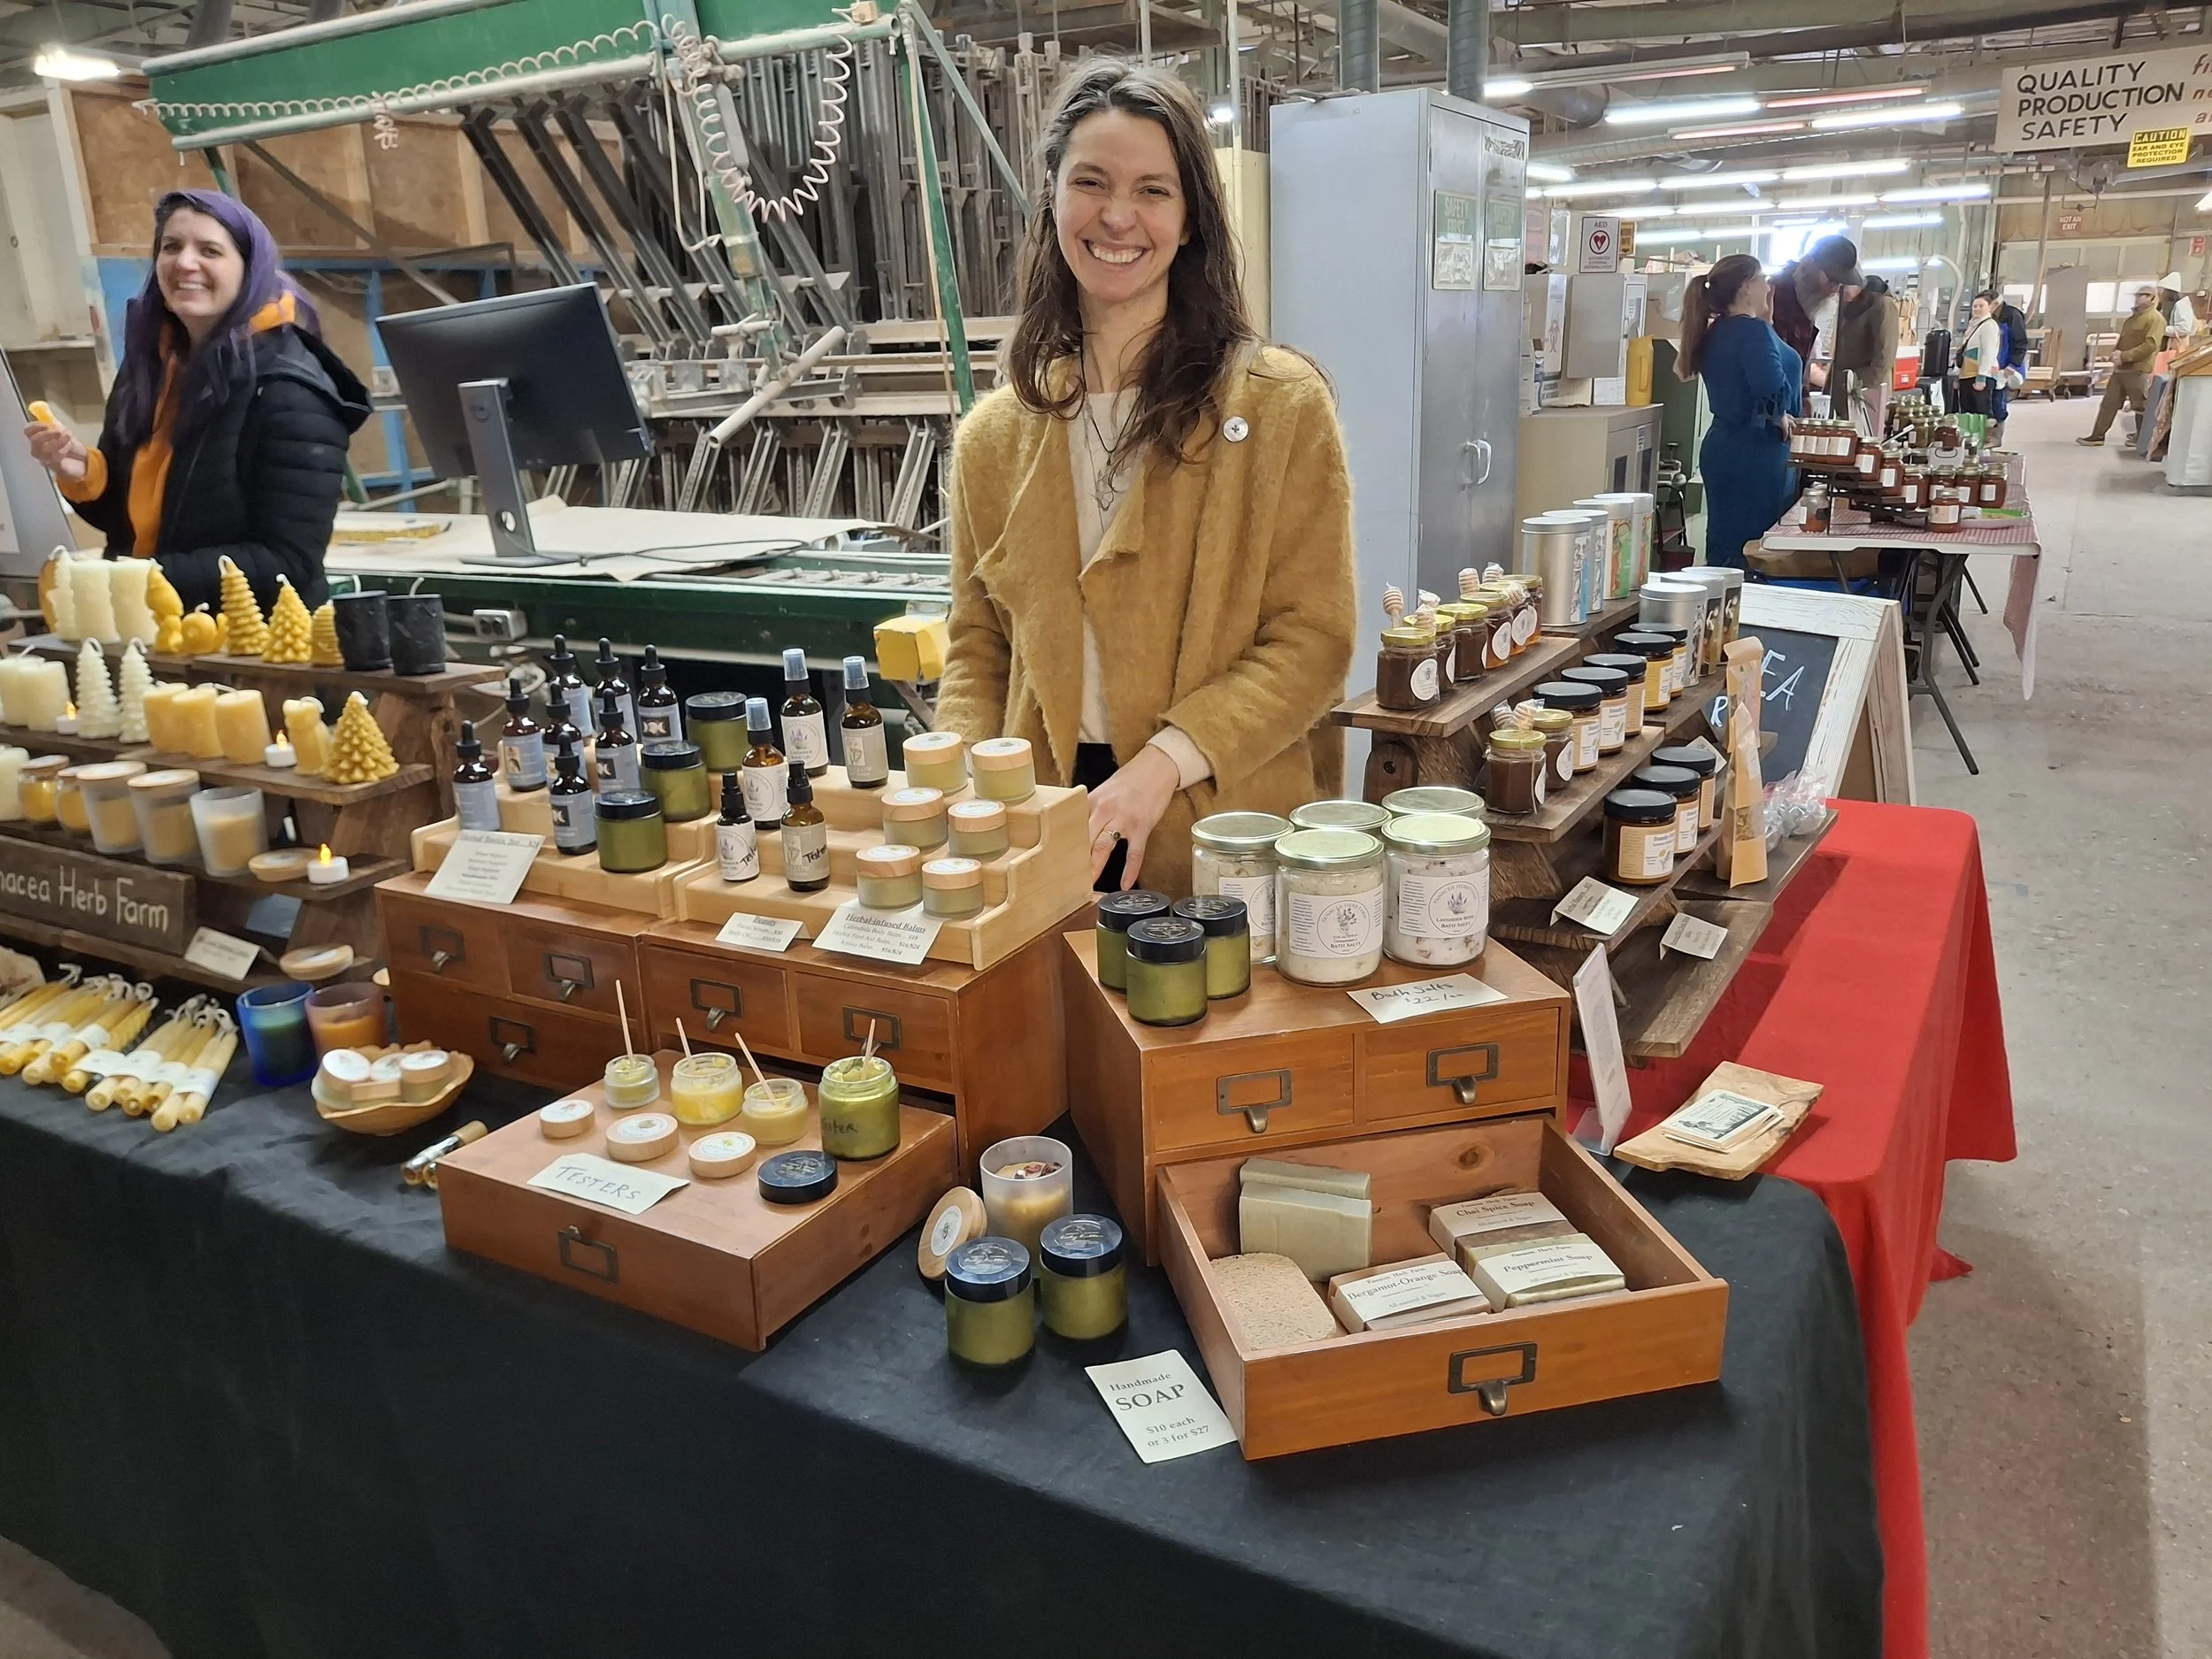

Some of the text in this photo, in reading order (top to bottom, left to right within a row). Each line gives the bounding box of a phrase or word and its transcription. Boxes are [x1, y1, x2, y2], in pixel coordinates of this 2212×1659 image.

[2016, 61, 2146, 95] QUALITY
[2017, 82, 2185, 117] PRODUCTION
[2021, 113, 2128, 141] SAFETY
[2135, 129, 2186, 143] CAUTION
[2132, 149, 2184, 157] PROTECTION
[2136, 155, 2177, 164] REQUIRED
[1444, 196, 1469, 219] SAFETY
[59, 864, 108, 916] Herb
[116, 877, 169, 933] Farm
[902, 923, 926, 933] Balms
[1371, 983, 1454, 1001] Bath Salts
[555, 1166, 641, 1200] TESTERS
[1456, 1207, 1480, 1217] Chai
[1503, 1256, 1564, 1272] Peppermint
[1347, 1273, 1438, 1300] Bergamot-Orange
[1110, 1372, 1172, 1392] Handmade
[1115, 1384, 1186, 1411] SOAP
[1146, 1416, 1195, 1435] $10 each
[1148, 1439, 1160, 1448] or
[1171, 1431, 1189, 1442] for
[1189, 1425, 1210, 1437] $27
